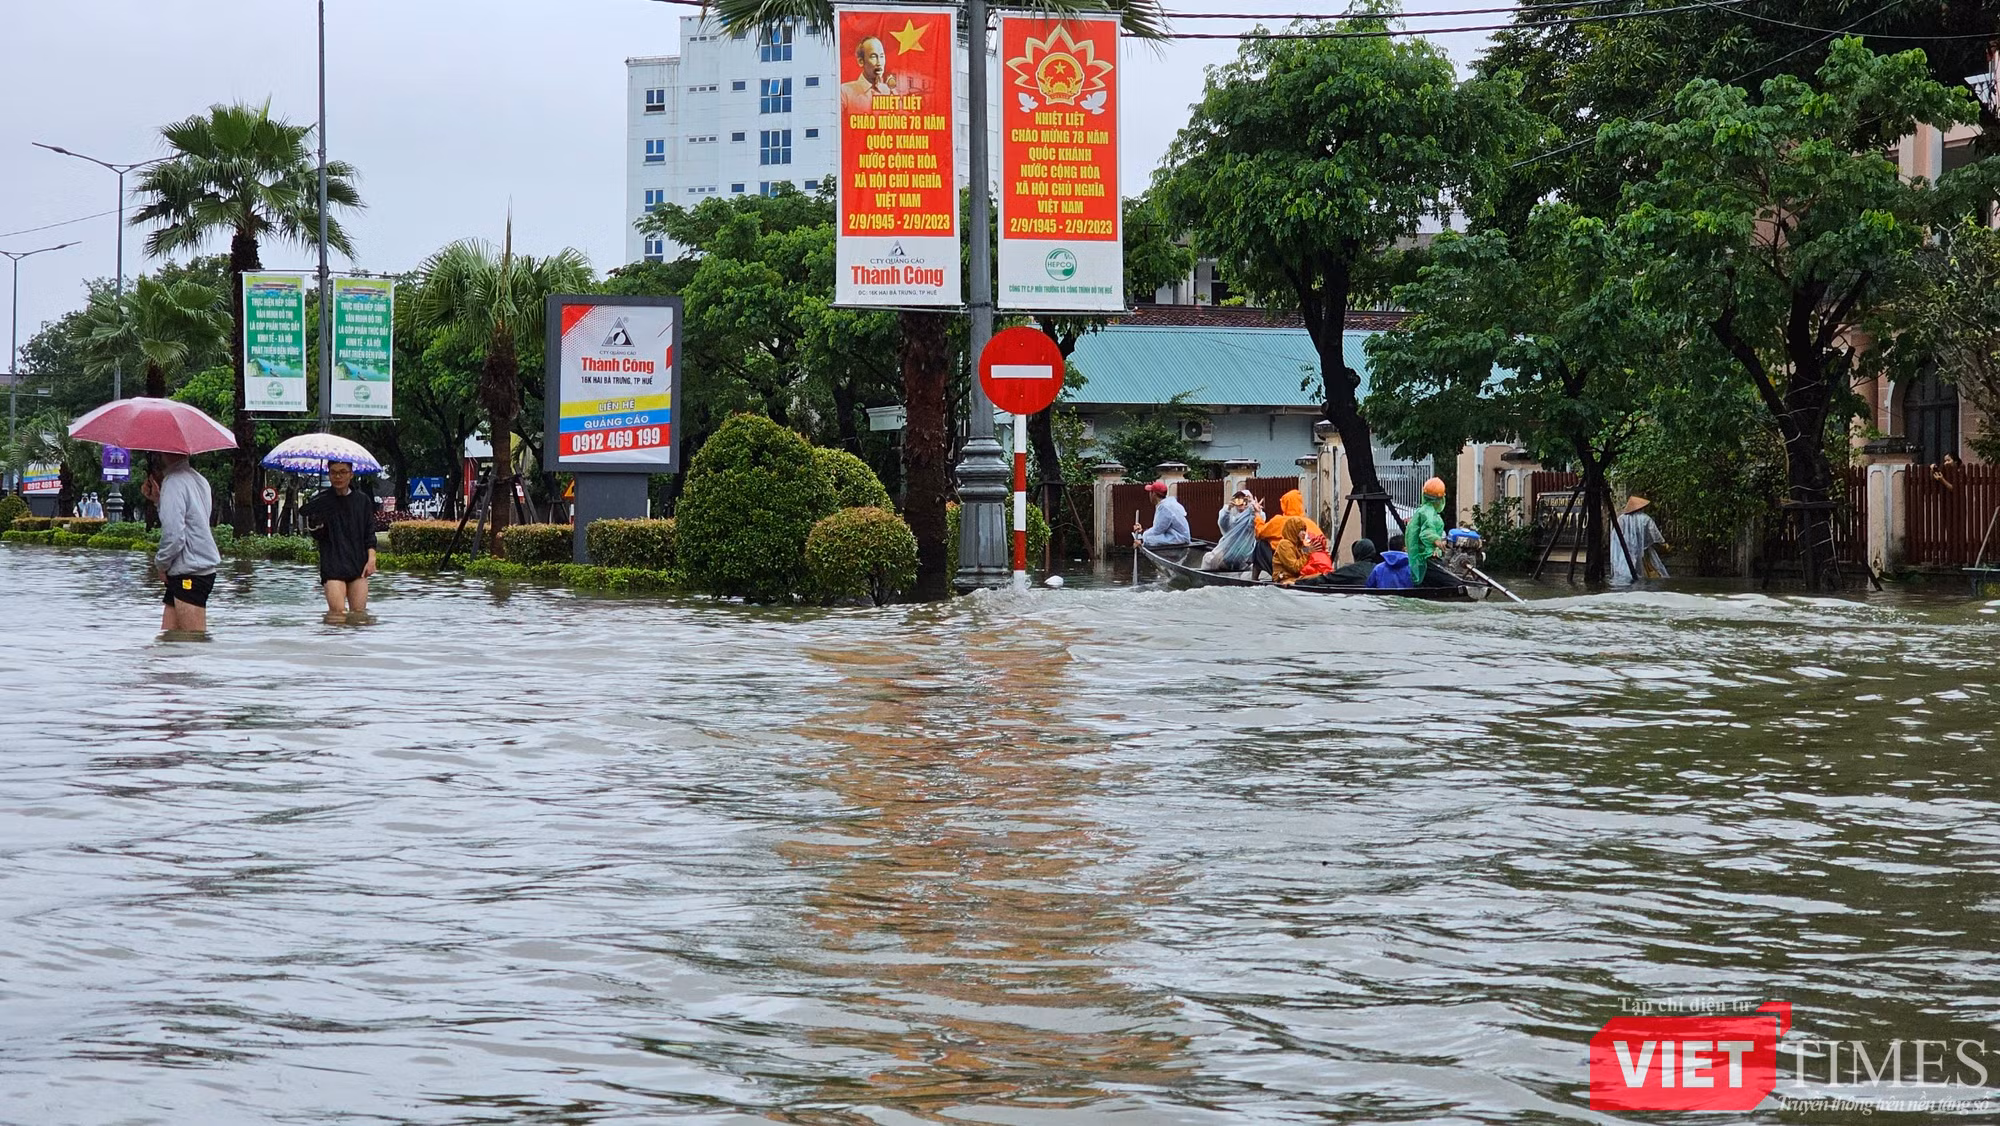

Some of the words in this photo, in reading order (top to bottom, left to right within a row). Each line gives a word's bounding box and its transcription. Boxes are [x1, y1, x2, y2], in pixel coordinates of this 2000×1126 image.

[872, 94, 900, 112] NHIỆT
[903, 94, 922, 112] LIỆT
[850, 114, 875, 129] CHÀO
[879, 114, 907, 129] MỪNG
[909, 115, 921, 129] 78
[924, 114, 945, 130] NĂM
[1035, 111, 1063, 127] NHIỆT
[1066, 111, 1085, 128] LIỆT
[867, 131, 893, 150] QUỐC
[896, 133, 929, 149] KHÁNH
[1012, 128, 1038, 142] CHÀO
[1041, 129, 1070, 143] MỪNG
[1073, 130, 1084, 144] 78
[1087, 130, 1109, 144] NĂM
[859, 153, 885, 168] NƯỚC
[888, 152, 914, 170] CỘNG
[917, 153, 937, 168] HÒA
[1029, 144, 1056, 161] QUỐC
[1058, 147, 1092, 161] KHÁNH
[854, 172, 866, 188] XÃ
[870, 172, 886, 190] HỘI
[889, 171, 909, 188] CHỦ
[912, 172, 942, 188] NGHĨA
[1021, 163, 1048, 178] NƯỚC
[1050, 164, 1078, 181] CỘNG
[1080, 165, 1100, 179] HÒA
[1016, 180, 1029, 195] XÃ
[1032, 181, 1048, 198] HỘI
[1051, 180, 1072, 196] CHỦ
[1074, 182, 1105, 197] NGHĨA
[876, 191, 896, 209] VIỆT
[900, 193, 921, 208] NAM
[1038, 199, 1059, 216] VIỆT
[1061, 201, 1084, 214] NAM
[849, 214, 894, 229] 2/9/1945
[903, 214, 950, 230] 2/9/2023
[1010, 218, 1057, 233] 2/9/1945
[1065, 219, 1113, 234] 2/9/2023
[851, 266, 900, 285] Thành
[903, 266, 943, 287] Công
[581, 357, 620, 372] Thành
[622, 358, 654, 374] Công
[581, 376, 591, 384] 16K
[604, 375, 611, 384] BÀ
[634, 377, 641, 385] TP
[642, 375, 653, 385] HUẾ
[599, 400, 619, 411] LIÊN
[622, 398, 635, 410] HỆ
[584, 416, 622, 429] QUẢNG
[625, 414, 649, 425] CÁO
[572, 433, 604, 452] 0912
[607, 430, 633, 449] 469
[636, 427, 660, 446] 199
